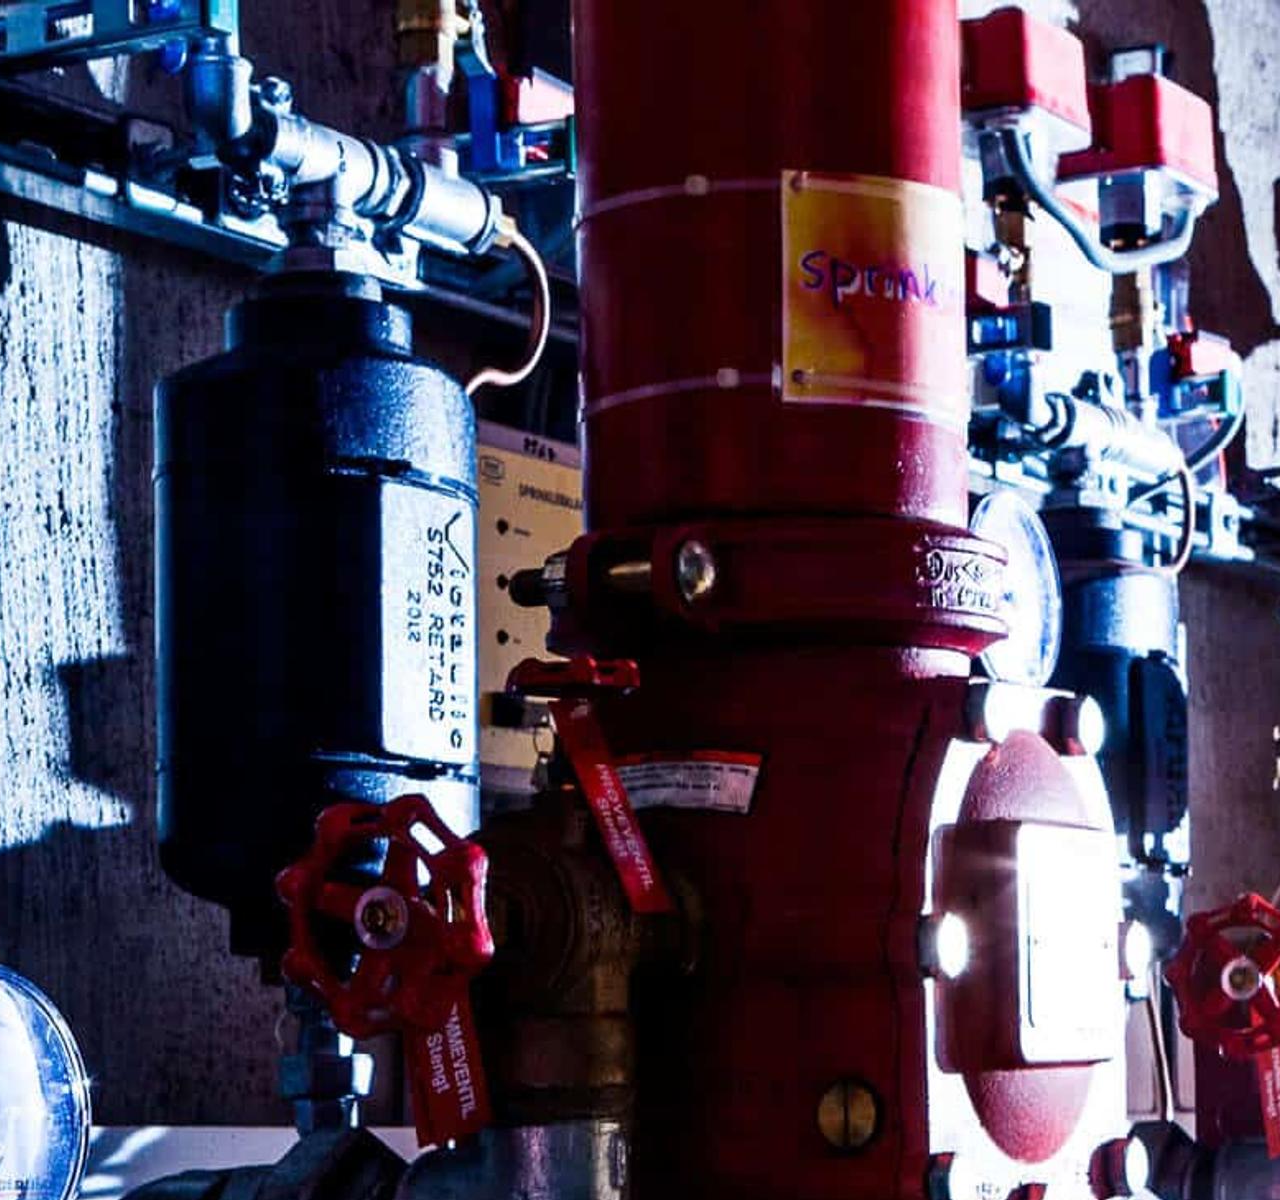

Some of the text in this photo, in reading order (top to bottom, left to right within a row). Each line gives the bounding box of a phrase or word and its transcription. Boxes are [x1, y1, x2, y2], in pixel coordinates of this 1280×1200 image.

[407, 589, 422, 643] 2012
[427, 526, 445, 722] S752 RETARD
